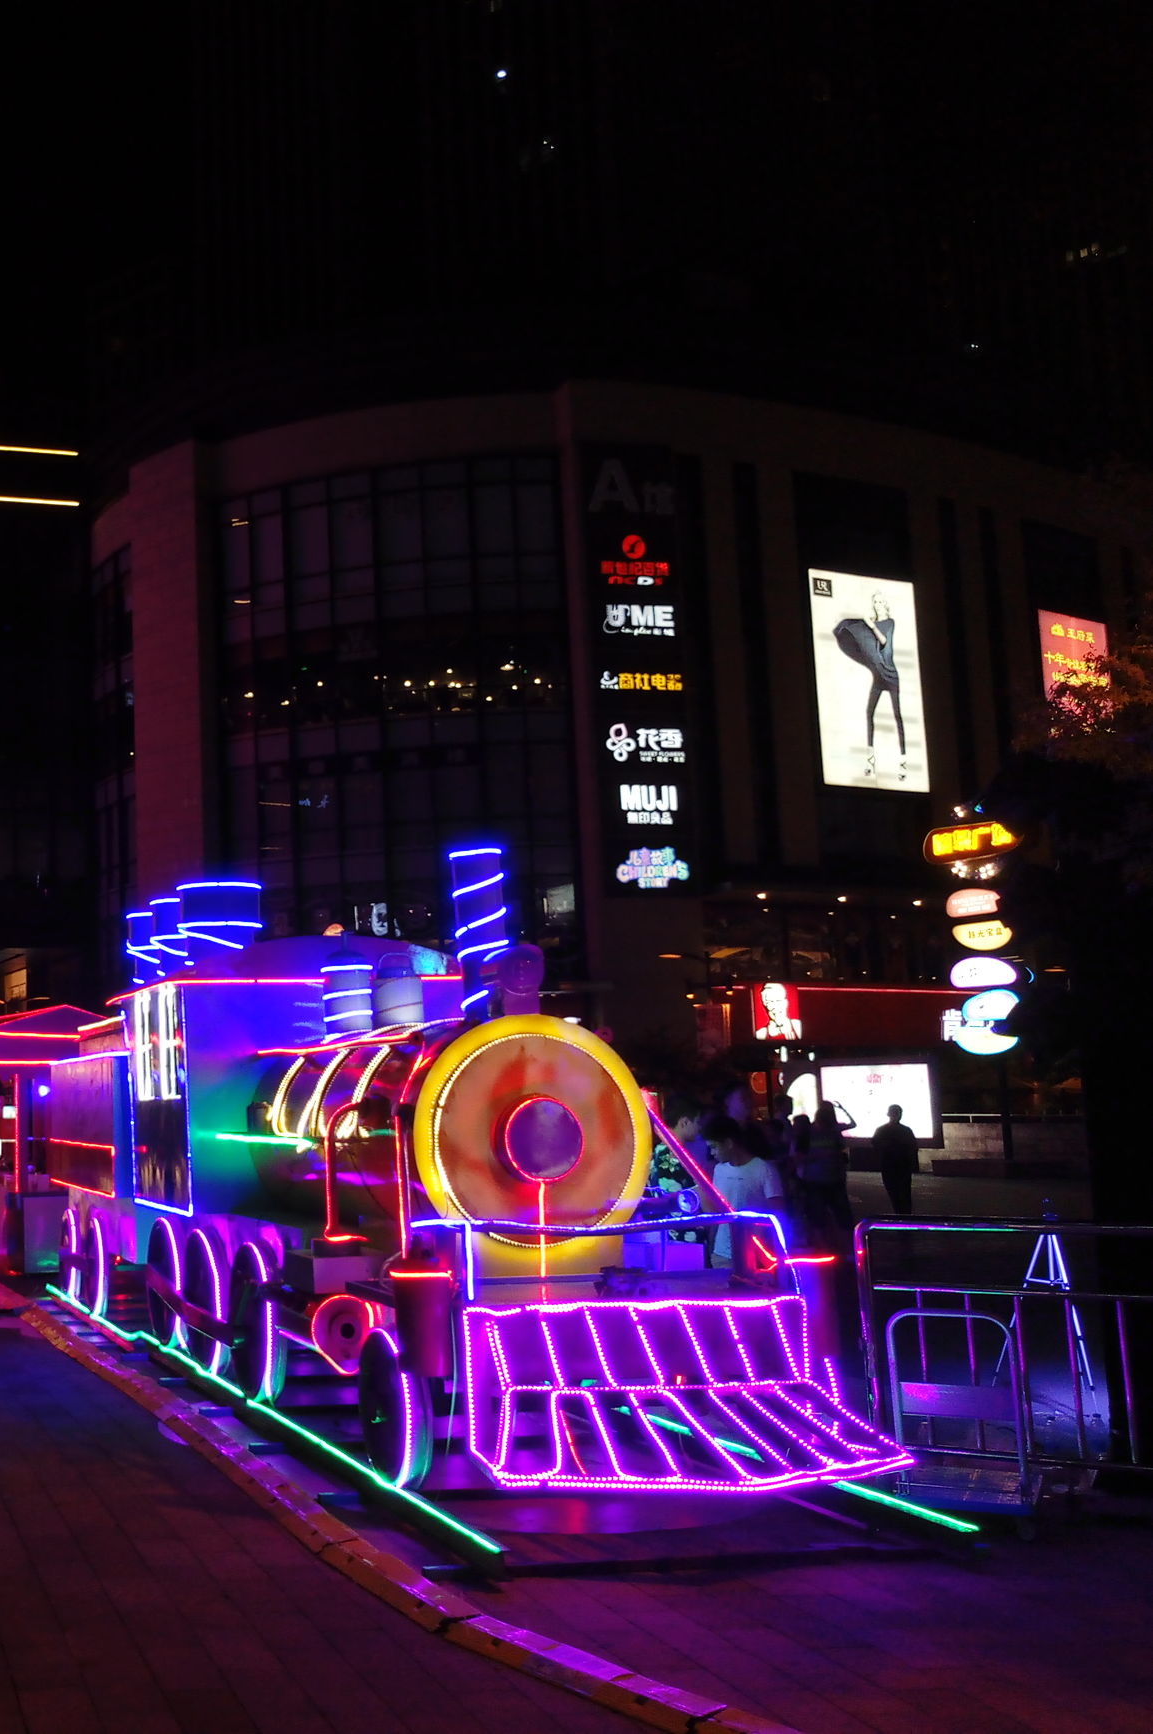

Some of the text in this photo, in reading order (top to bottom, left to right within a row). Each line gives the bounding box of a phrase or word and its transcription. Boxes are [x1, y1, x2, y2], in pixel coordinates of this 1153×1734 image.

[618, 672, 684, 692] 商社电器
[635, 727, 684, 752] 花香
[619, 784, 679, 811] MUJI
[625, 846, 676, 866] 儿童故事
[637, 877, 670, 889] STORY
